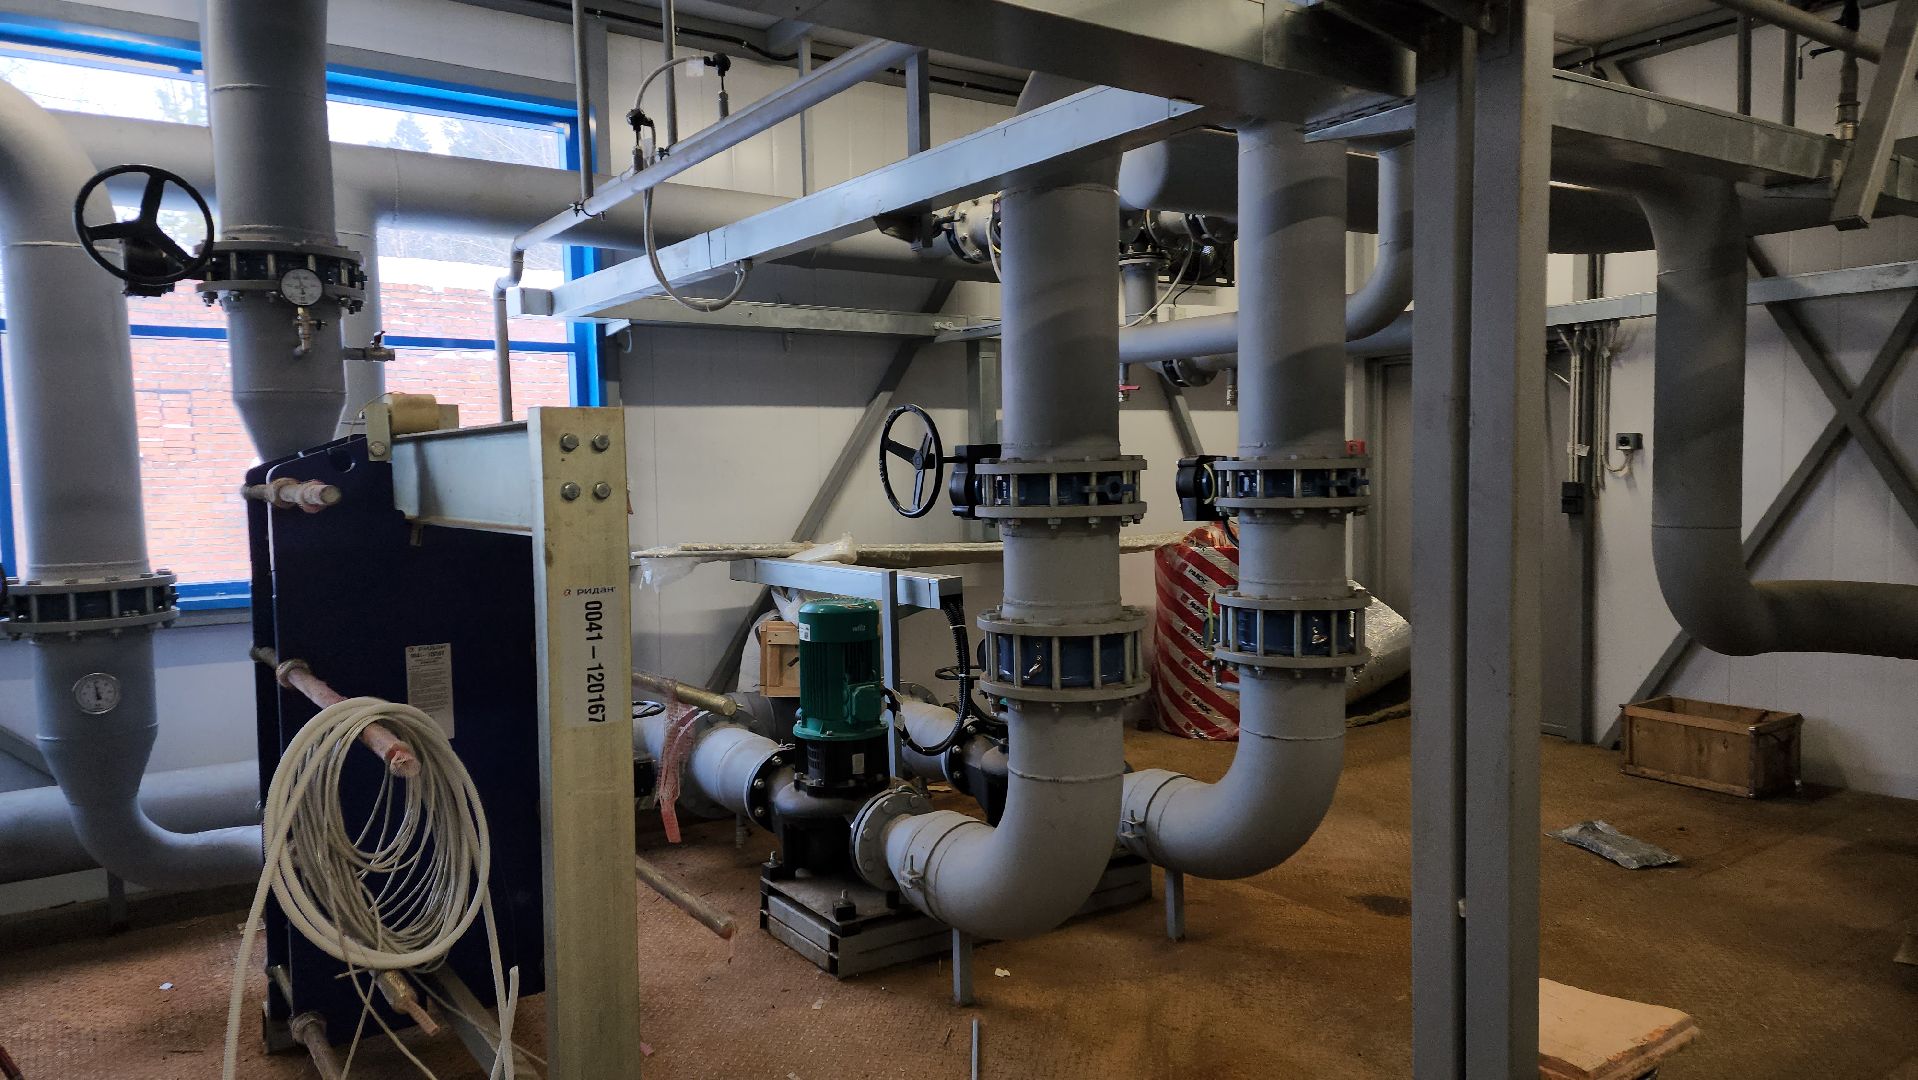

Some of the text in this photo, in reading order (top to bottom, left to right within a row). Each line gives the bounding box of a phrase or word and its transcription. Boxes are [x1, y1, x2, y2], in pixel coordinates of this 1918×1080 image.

[577, 586, 614, 596] ридан
[1188, 568, 1208, 585] PAROC
[585, 600, 603, 641] 0041
[586, 663, 606, 723] 120167
